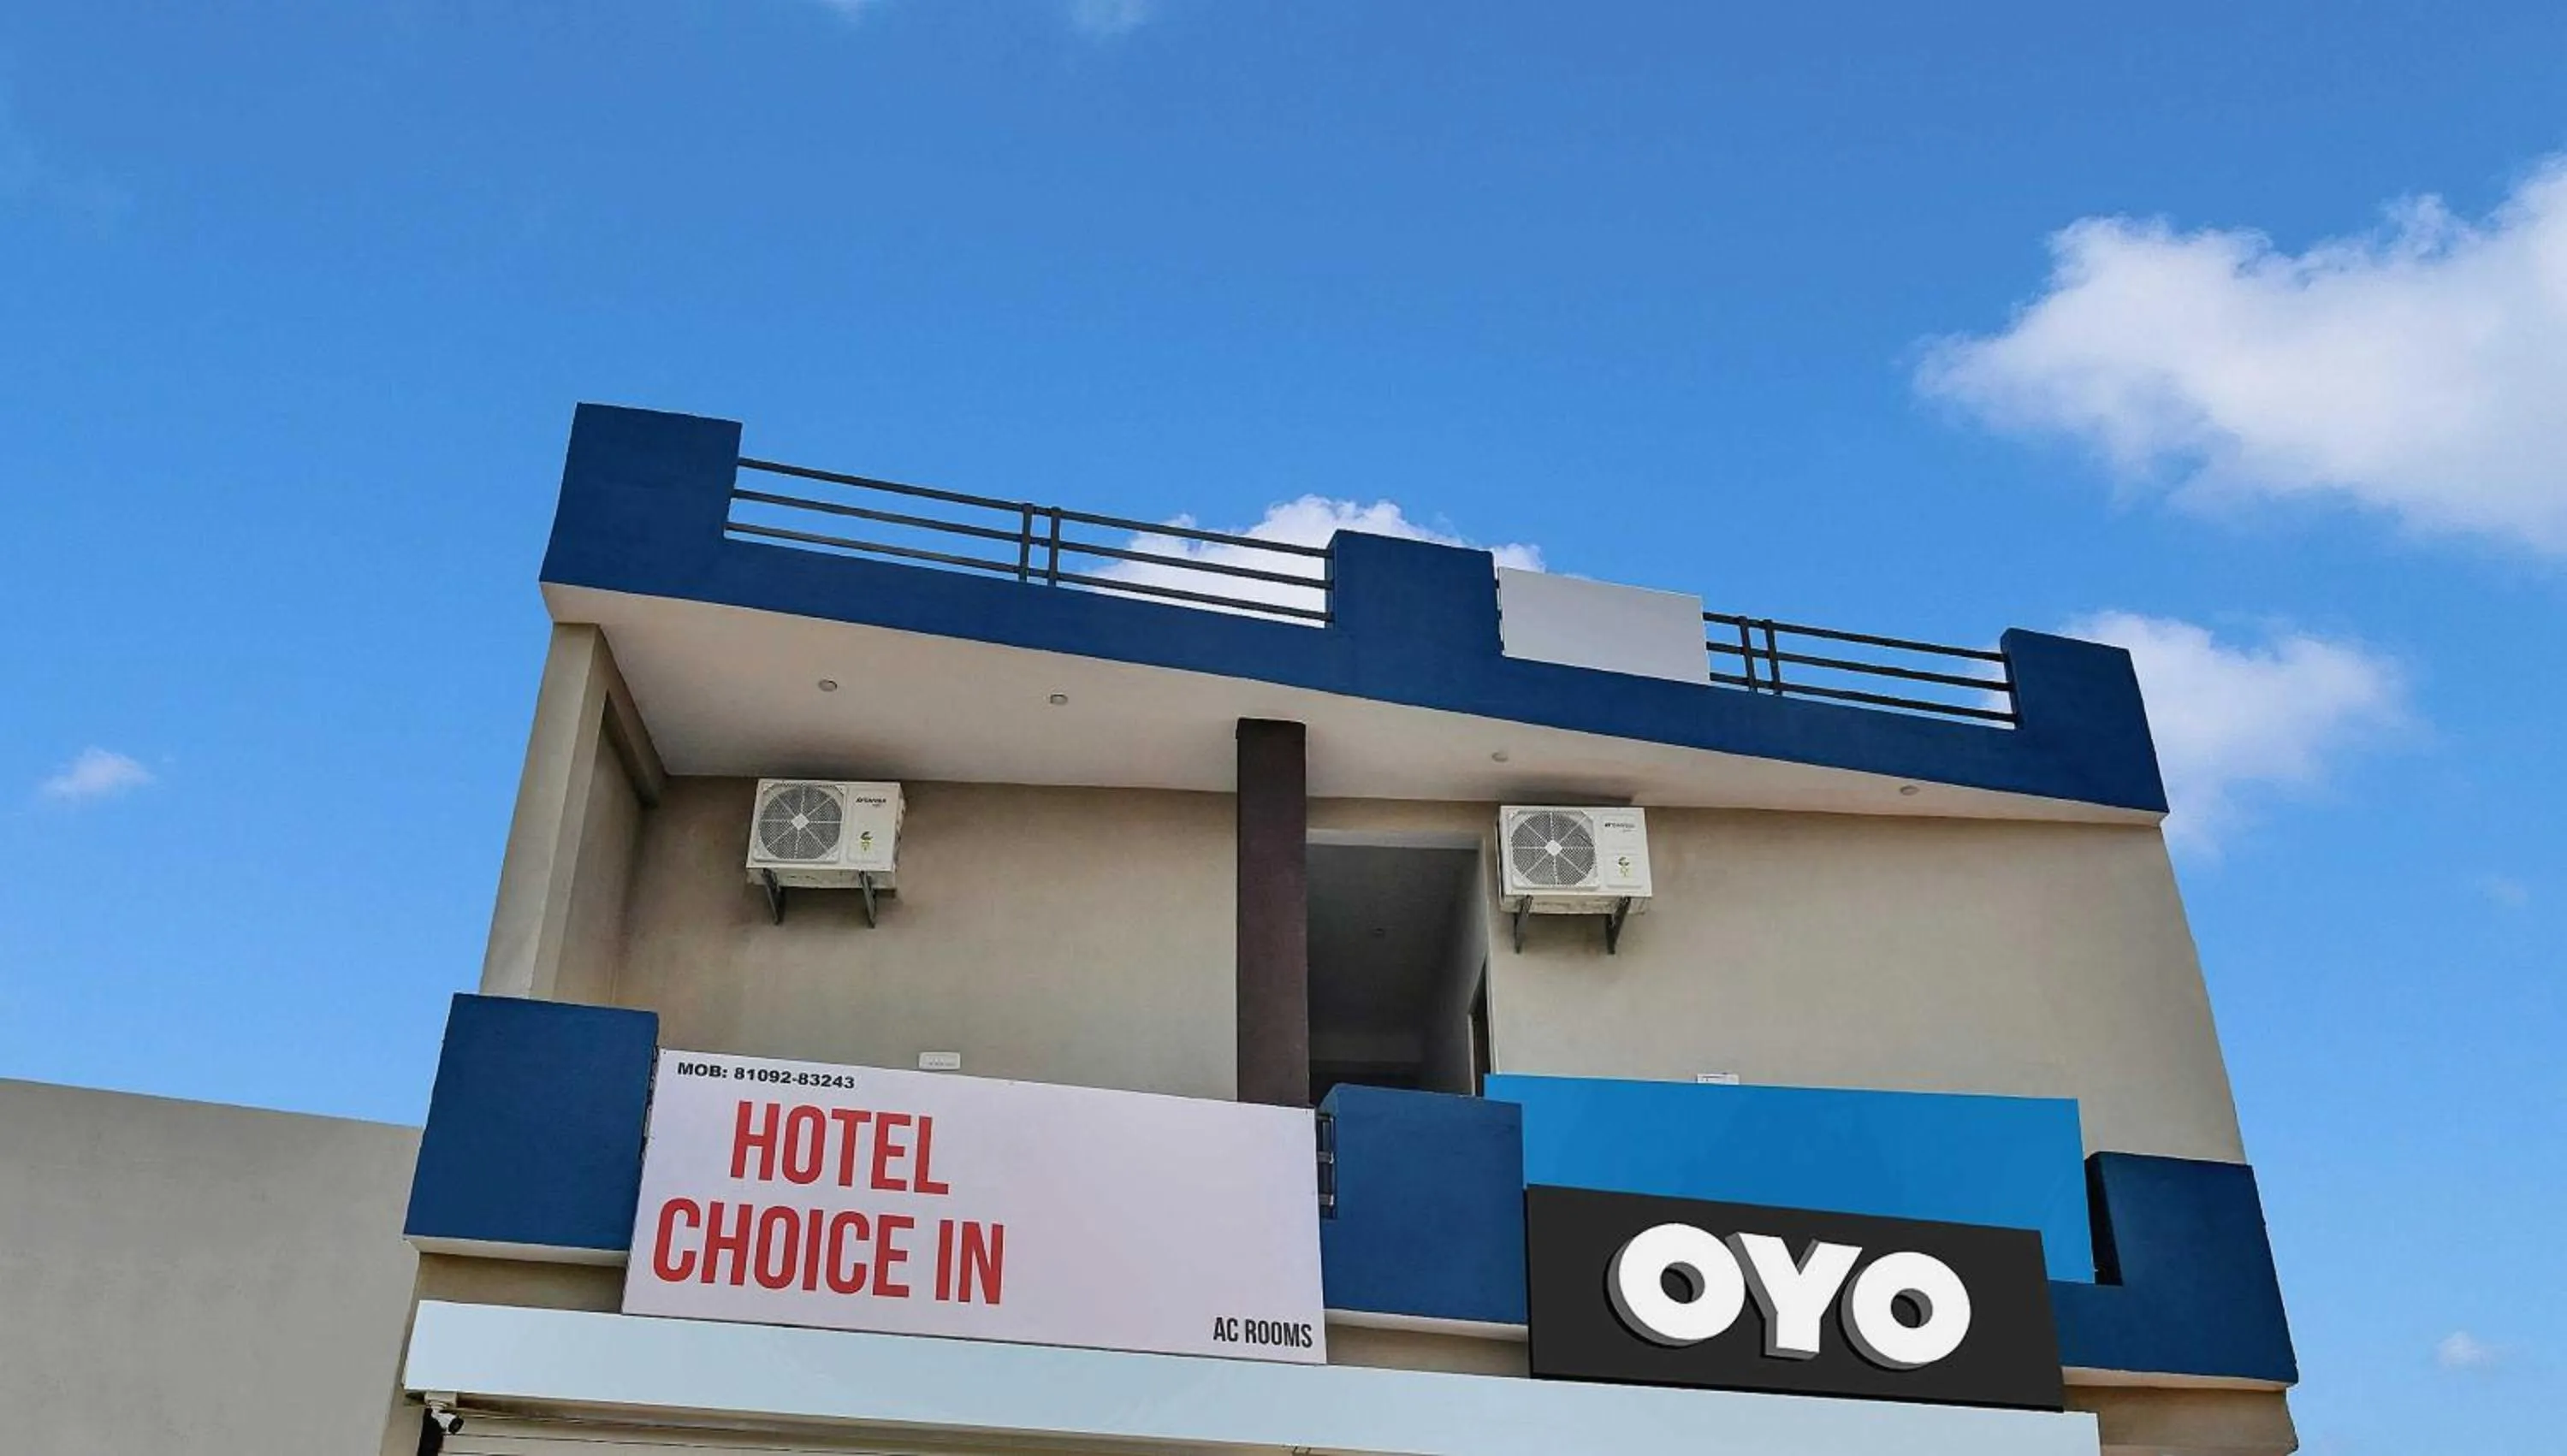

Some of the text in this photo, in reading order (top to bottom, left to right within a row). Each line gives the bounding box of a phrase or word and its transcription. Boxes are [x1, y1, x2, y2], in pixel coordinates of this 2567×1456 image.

[677, 1062, 856, 1089] MOB: 81092-83243
[732, 1101, 948, 1195] HOTEL
[653, 1198, 1005, 1305] CHOICE IN
[1609, 1222, 1971, 1370] OYO
[1212, 1317, 1313, 1348] AC ROOMS
